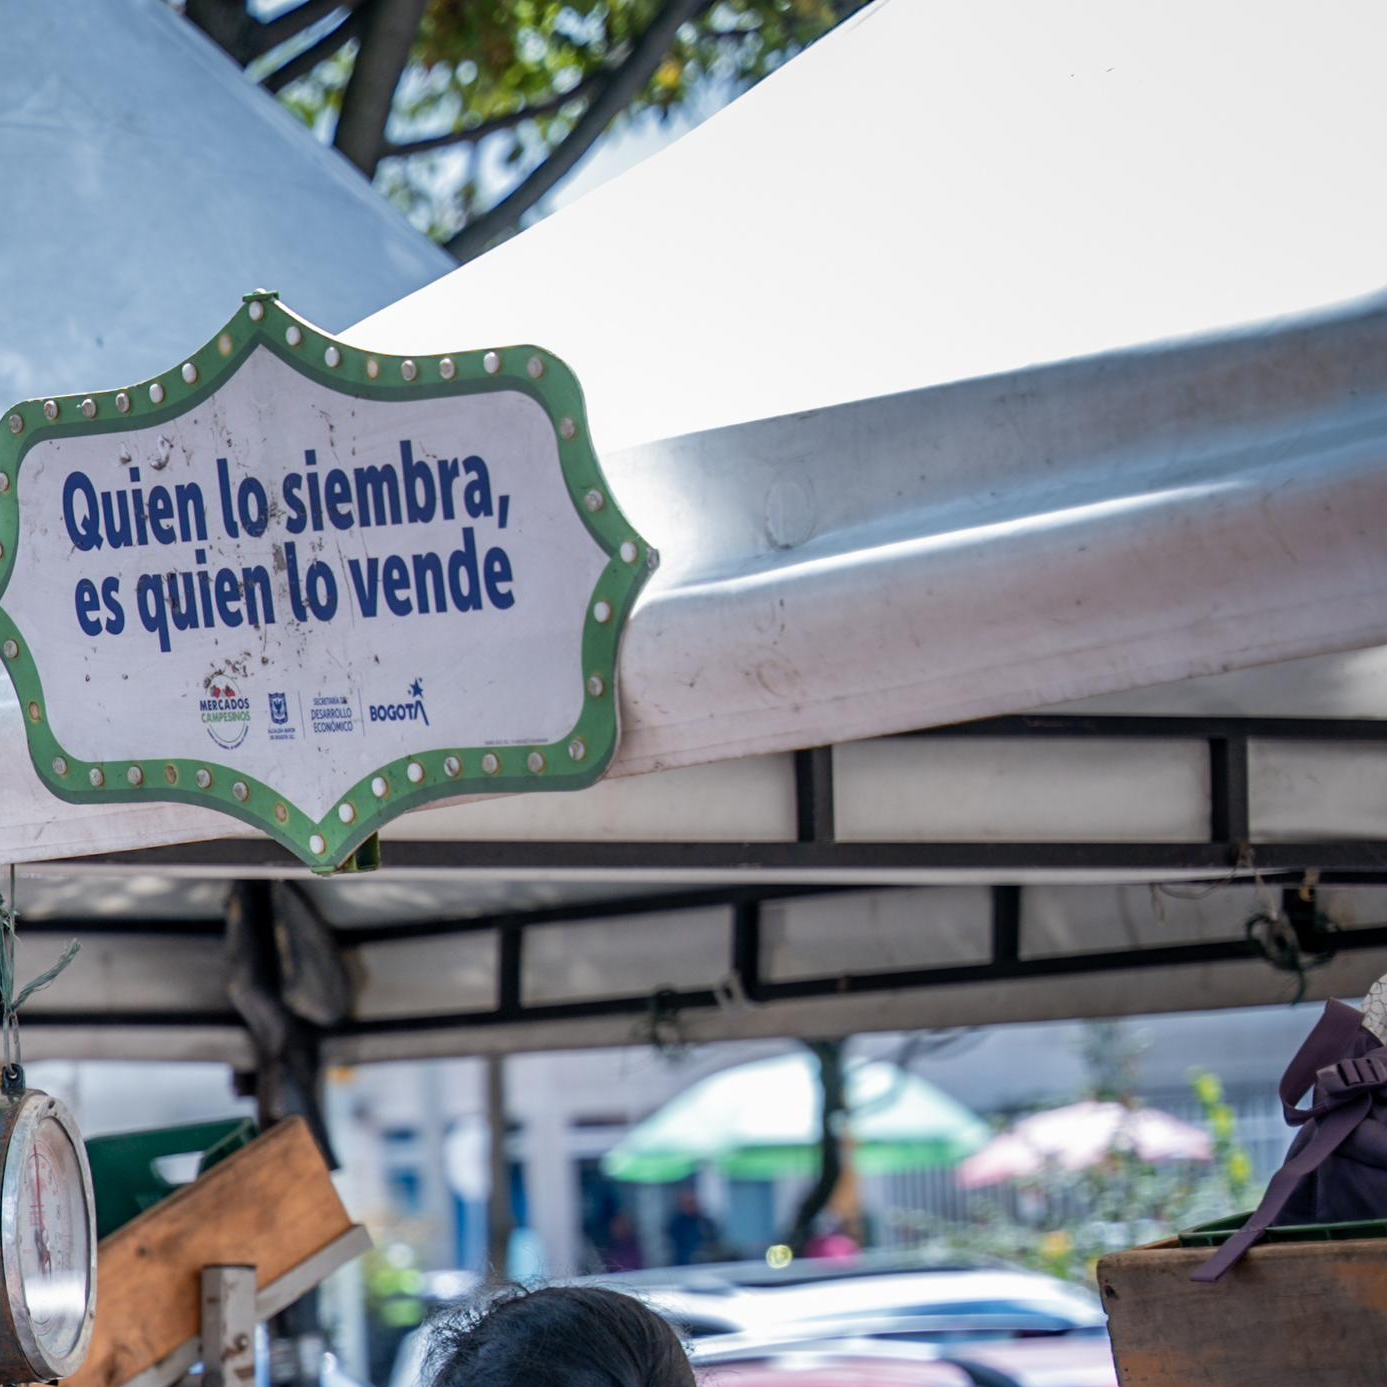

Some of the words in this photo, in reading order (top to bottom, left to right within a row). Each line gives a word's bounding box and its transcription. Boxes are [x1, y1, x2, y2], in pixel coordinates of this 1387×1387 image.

[62, 467, 208, 552] Quien
[216, 458, 268, 539] lo
[283, 439, 511, 533] siembra,
[74, 569, 125, 636] es
[139, 548, 276, 653] quien
[284, 540, 338, 625] lo
[347, 527, 516, 618] vende
[199, 698, 250, 711] MERCADOS
[201, 711, 252, 723] CAMPESINOS
[311, 707, 352, 721] DESARROLLO
[313, 720, 354, 733] ECONÓMICO
